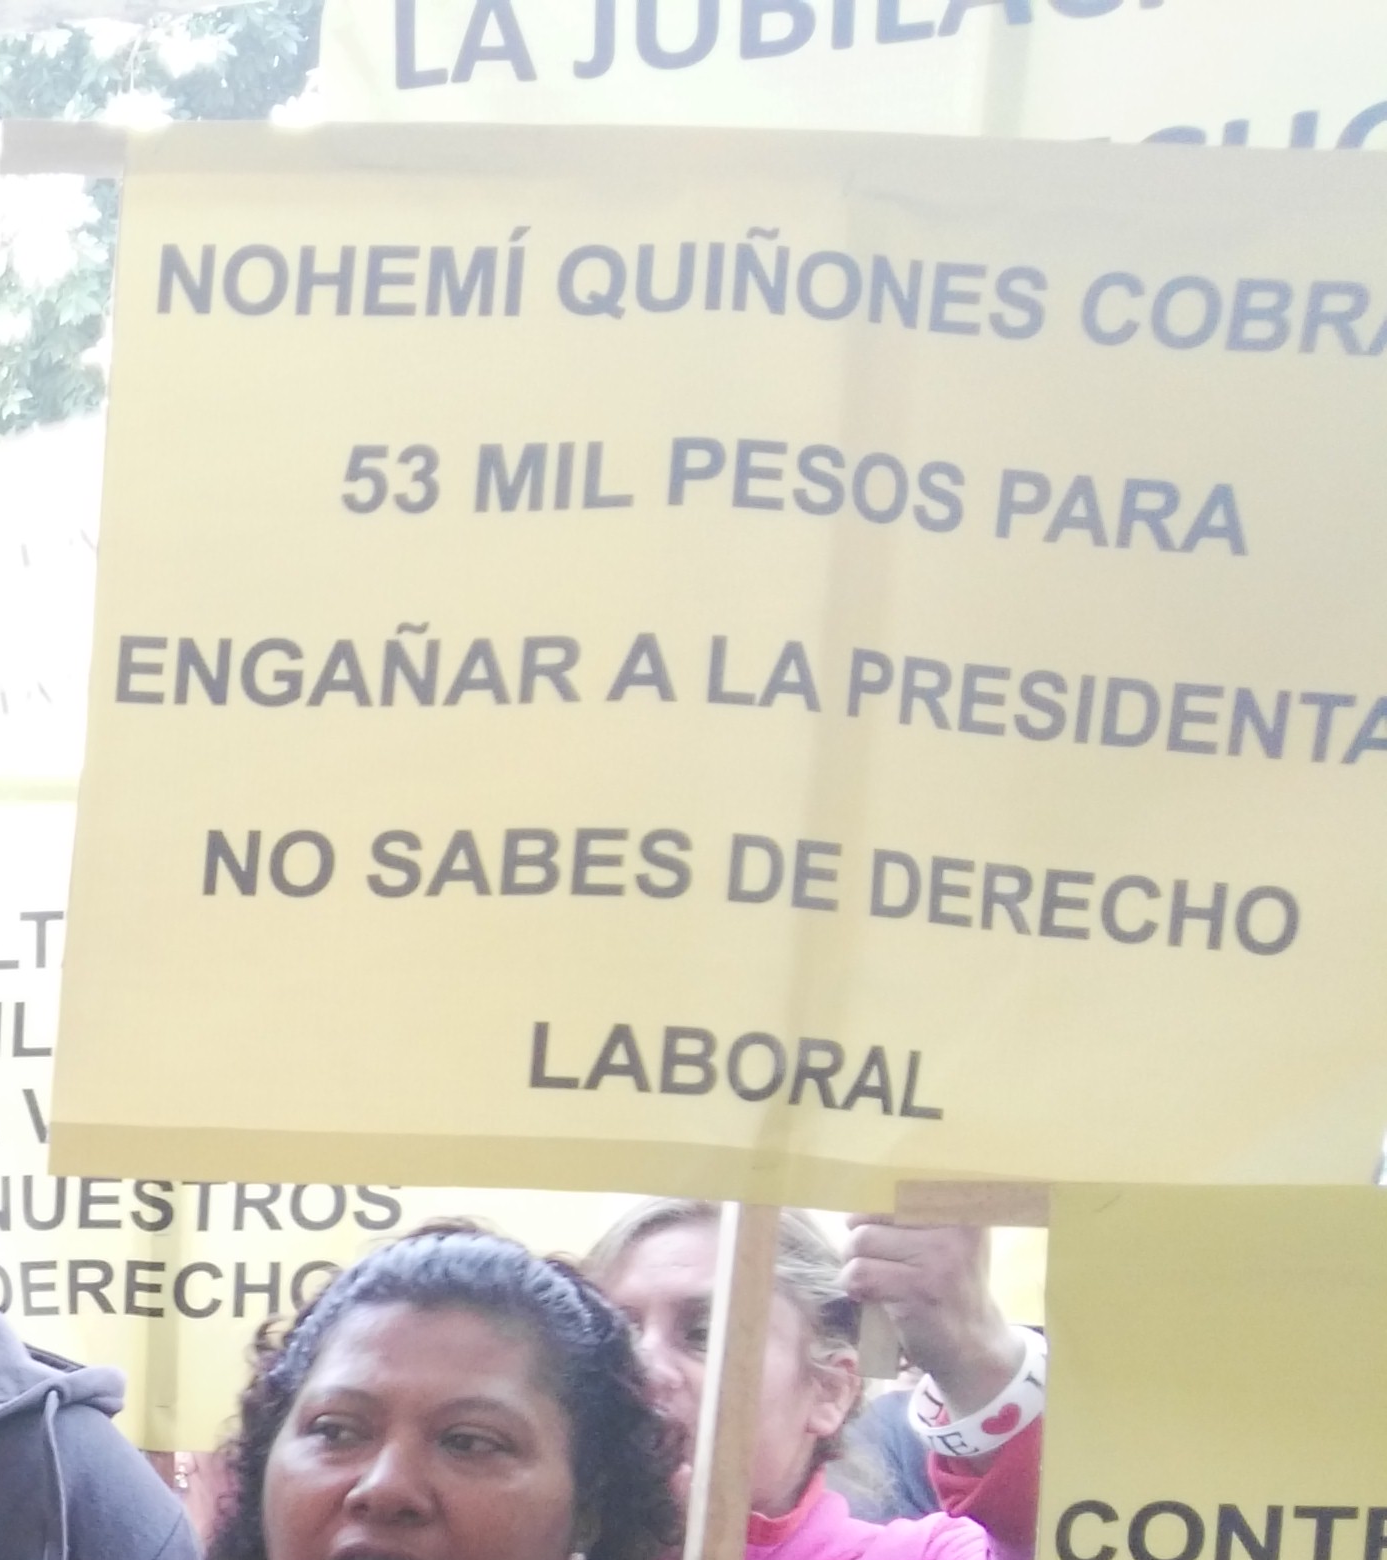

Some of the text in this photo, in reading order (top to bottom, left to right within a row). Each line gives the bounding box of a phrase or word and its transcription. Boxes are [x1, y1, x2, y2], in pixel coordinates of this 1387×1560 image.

[156, 226, 526, 319] NOHEMÍ
[556, 228, 1048, 342] QUIÑONES
[343, 437, 1249, 557] 53 MIL PESOS PARA
[114, 622, 582, 709] ENGAÑAR
[606, 633, 677, 702] A
[705, 638, 822, 713] LA
[200, 828, 1300, 957] NO SABES DE DERECHO
[526, 1021, 943, 1121] LABORAL
